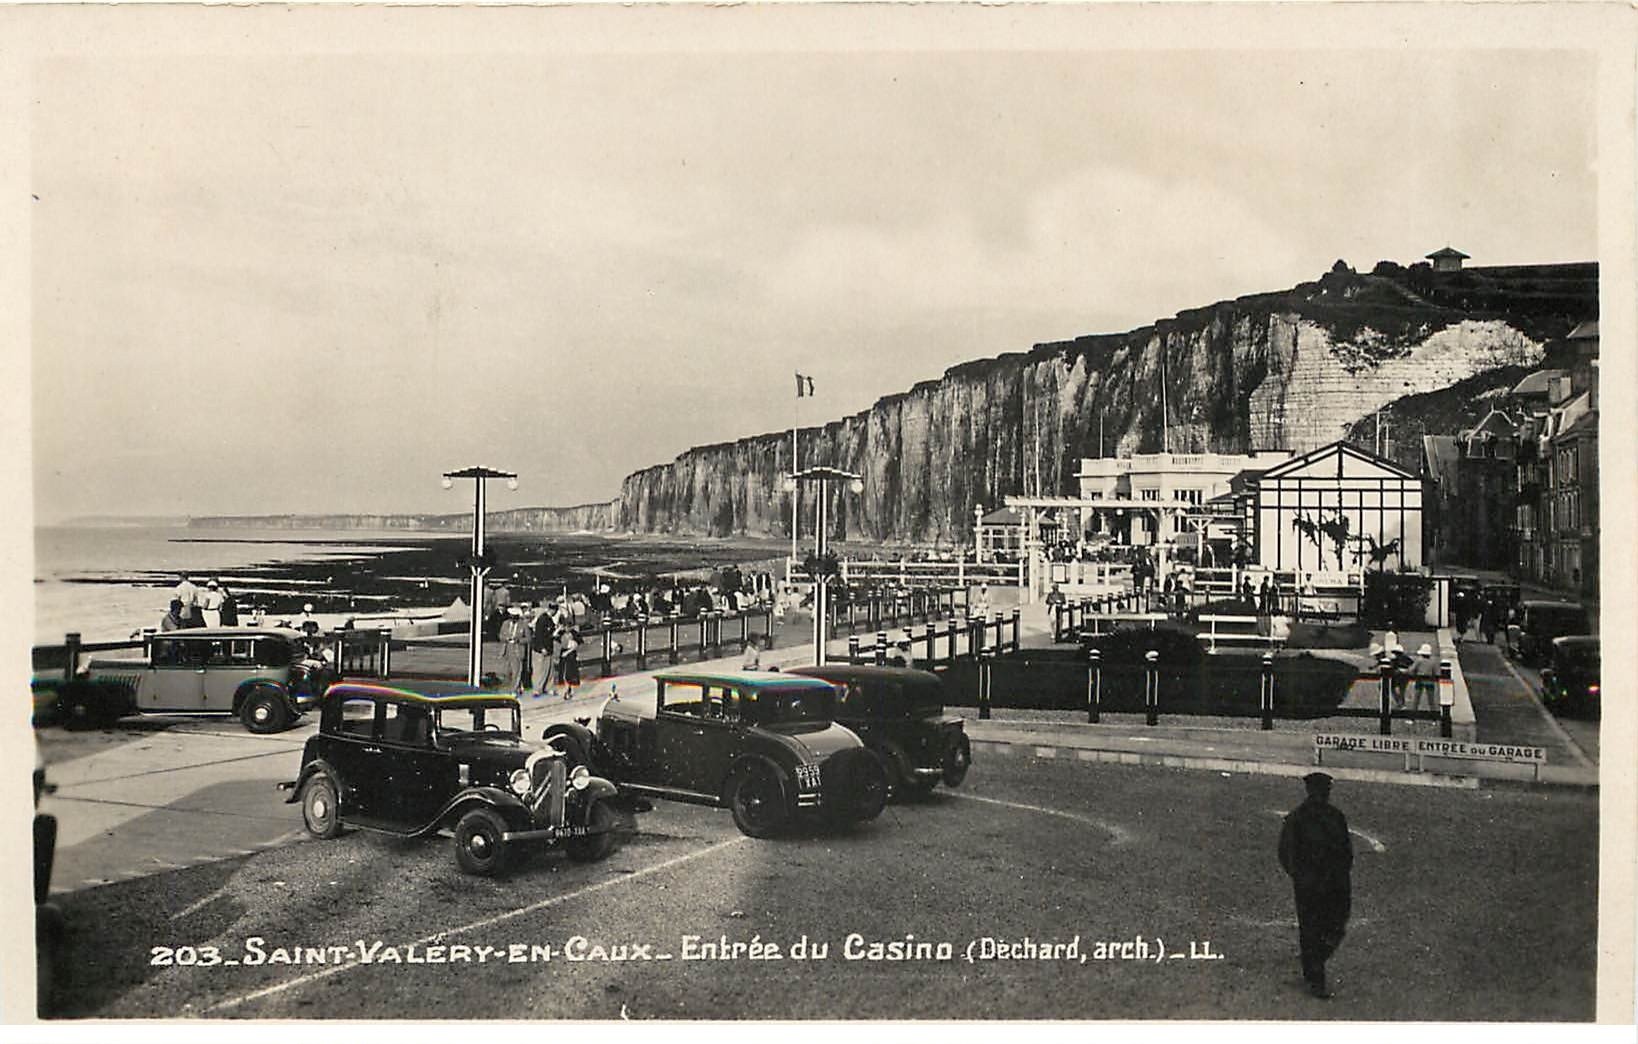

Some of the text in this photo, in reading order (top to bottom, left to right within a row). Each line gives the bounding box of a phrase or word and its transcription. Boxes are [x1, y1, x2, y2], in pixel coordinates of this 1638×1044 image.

[1316, 735, 1409, 751] GARAGE LIBRE
[1488, 746, 1542, 758] GARAGE
